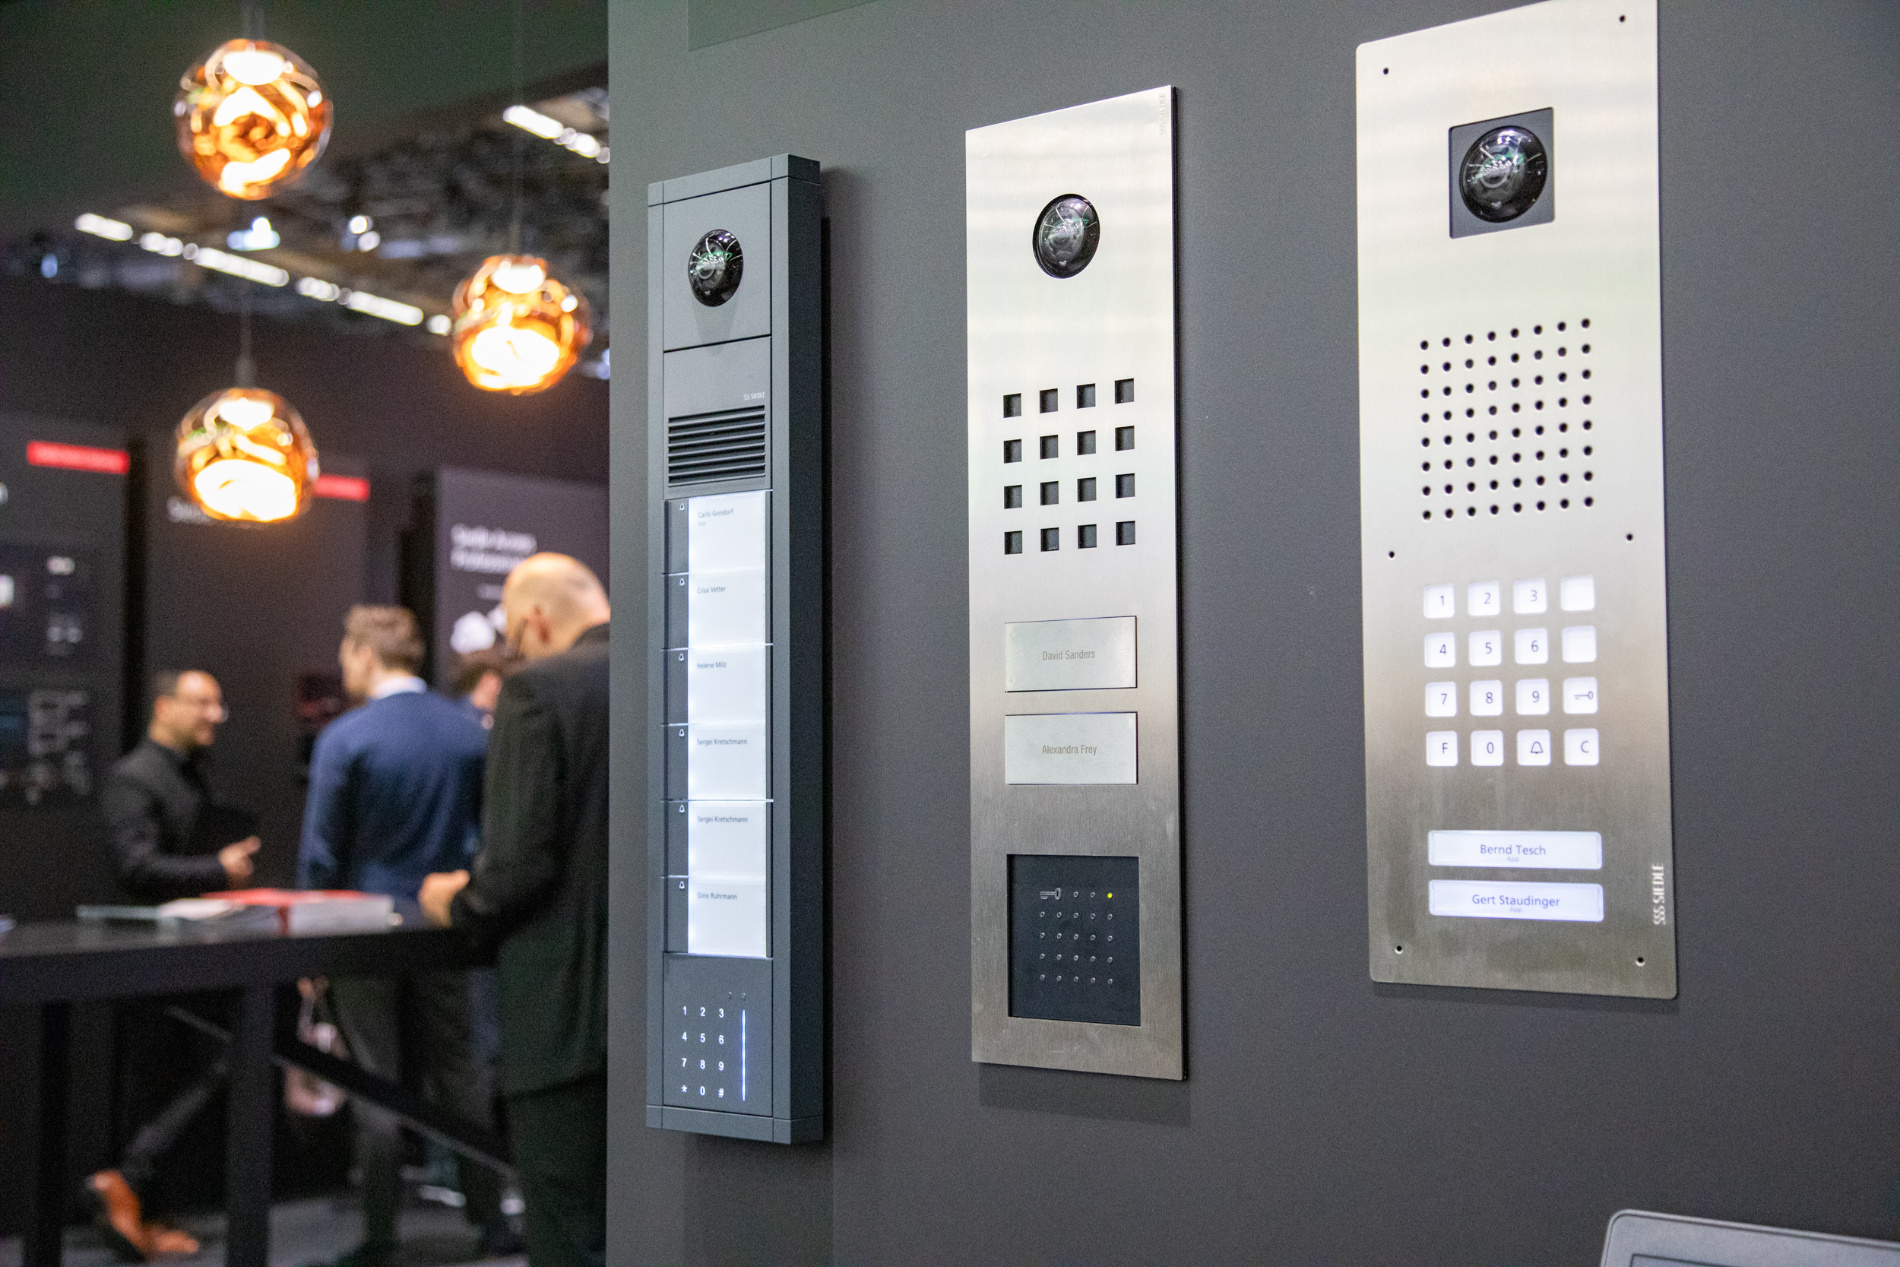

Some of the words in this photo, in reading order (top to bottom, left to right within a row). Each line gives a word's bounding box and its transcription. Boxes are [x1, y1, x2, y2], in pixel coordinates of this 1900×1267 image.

[1439, 594, 1445, 607] 1
[1484, 592, 1492, 604] 2
[1530, 589, 1538, 602] 3
[1439, 643, 1447, 655] 4
[1485, 642, 1492, 654] 5
[1531, 639, 1539, 652] 6
[1042, 651, 1063, 660] David
[1065, 649, 1096, 660] Sanders
[1440, 692, 1448, 704] 7
[1485, 691, 1494, 704] 8
[1532, 690, 1540, 703] 9
[1042, 744, 1079, 754] Alexandra
[1080, 744, 1097, 756] Frey
[1442, 742, 1448, 754] F
[1580, 740, 1590, 753] C
[697, 816, 713, 824] Sergei
[1480, 844, 1512, 855] Bernd
[1515, 844, 1546, 855] Tesch
[1651, 864, 1665, 903] SIEDLE
[1472, 894, 1495, 905] Gert
[1499, 895, 1560, 909] Staudinger
[683, 1006, 687, 1015] 1
[701, 1007, 705, 1017] 2
[719, 1009, 724, 1018] 3
[682, 1032, 687, 1041] 4
[701, 1033, 705, 1043] 5
[719, 1035, 724, 1044] 6
[682, 1058, 687, 1067] 7
[700, 1060, 705, 1069] 8
[719, 1061, 724, 1071] 9
[700, 1086, 705, 1096] 0
